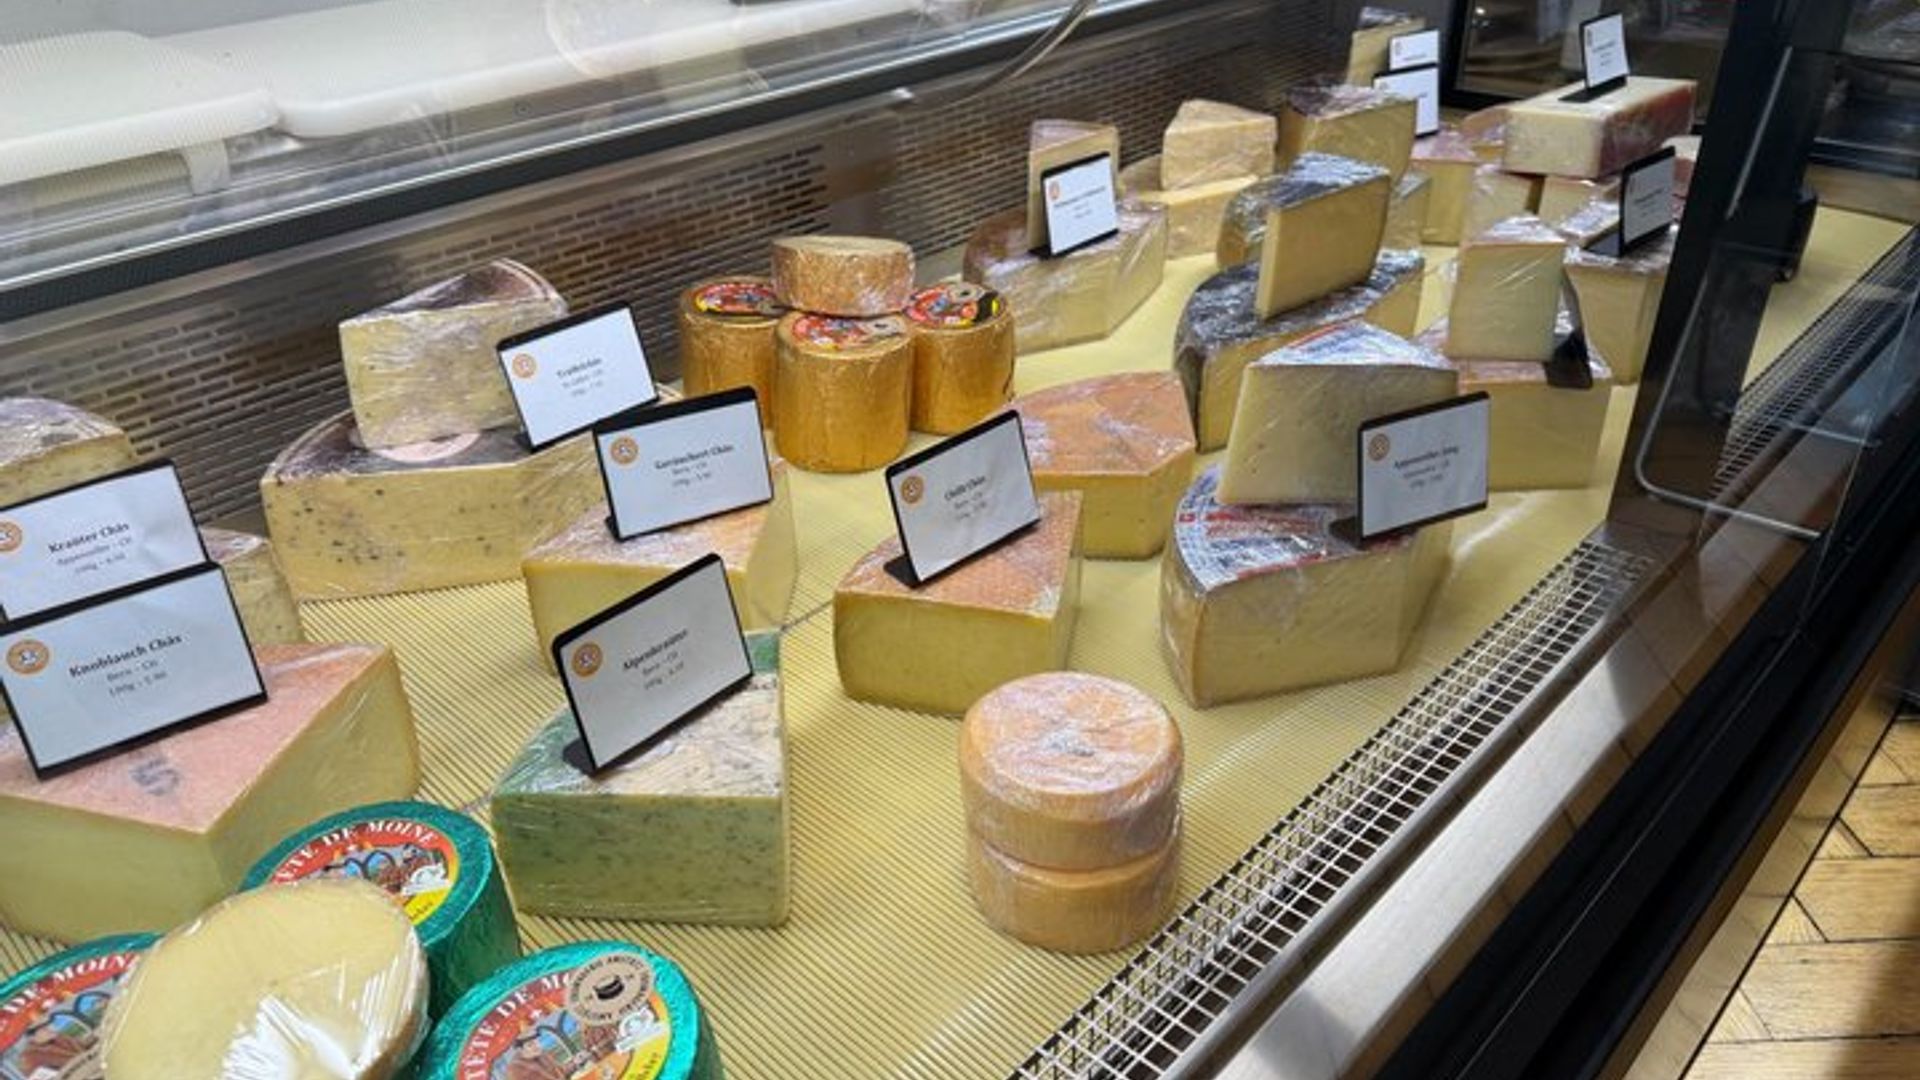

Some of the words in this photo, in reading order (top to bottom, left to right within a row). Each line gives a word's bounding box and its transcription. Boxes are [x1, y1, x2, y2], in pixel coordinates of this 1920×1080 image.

[69, 646, 148, 678] Knoblauch
[322, 828, 359, 846] DE
[367, 819, 438, 844] MOINE
[2, 983, 50, 1013] DE
[497, 986, 536, 1018] DE
